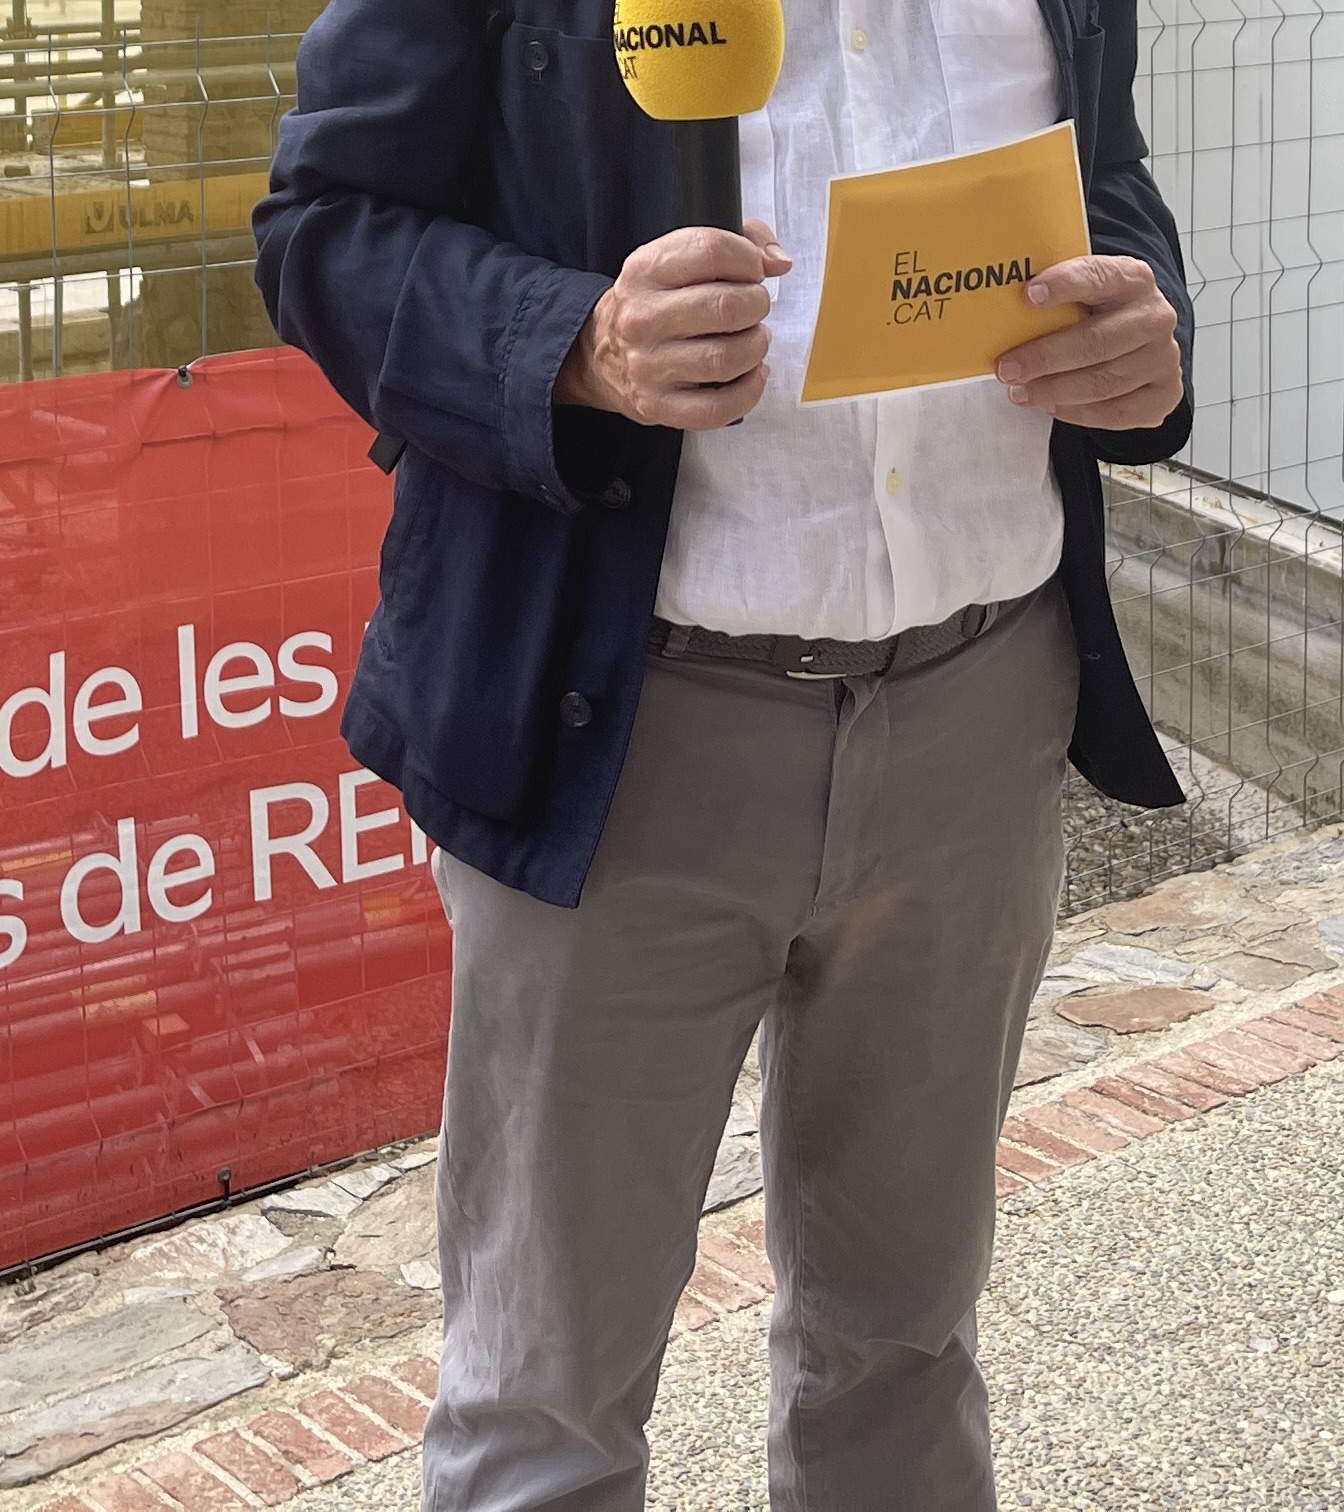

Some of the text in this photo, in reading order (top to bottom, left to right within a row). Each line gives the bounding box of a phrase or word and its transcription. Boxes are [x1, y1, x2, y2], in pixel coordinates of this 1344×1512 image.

[117, 198, 195, 231] ULMA
[890, 256, 1037, 302] NACIONAL
[894, 250, 927, 276] EL
[886, 297, 953, 326] .CAT
[177, 624, 339, 739] les
[59, 818, 215, 944] de
